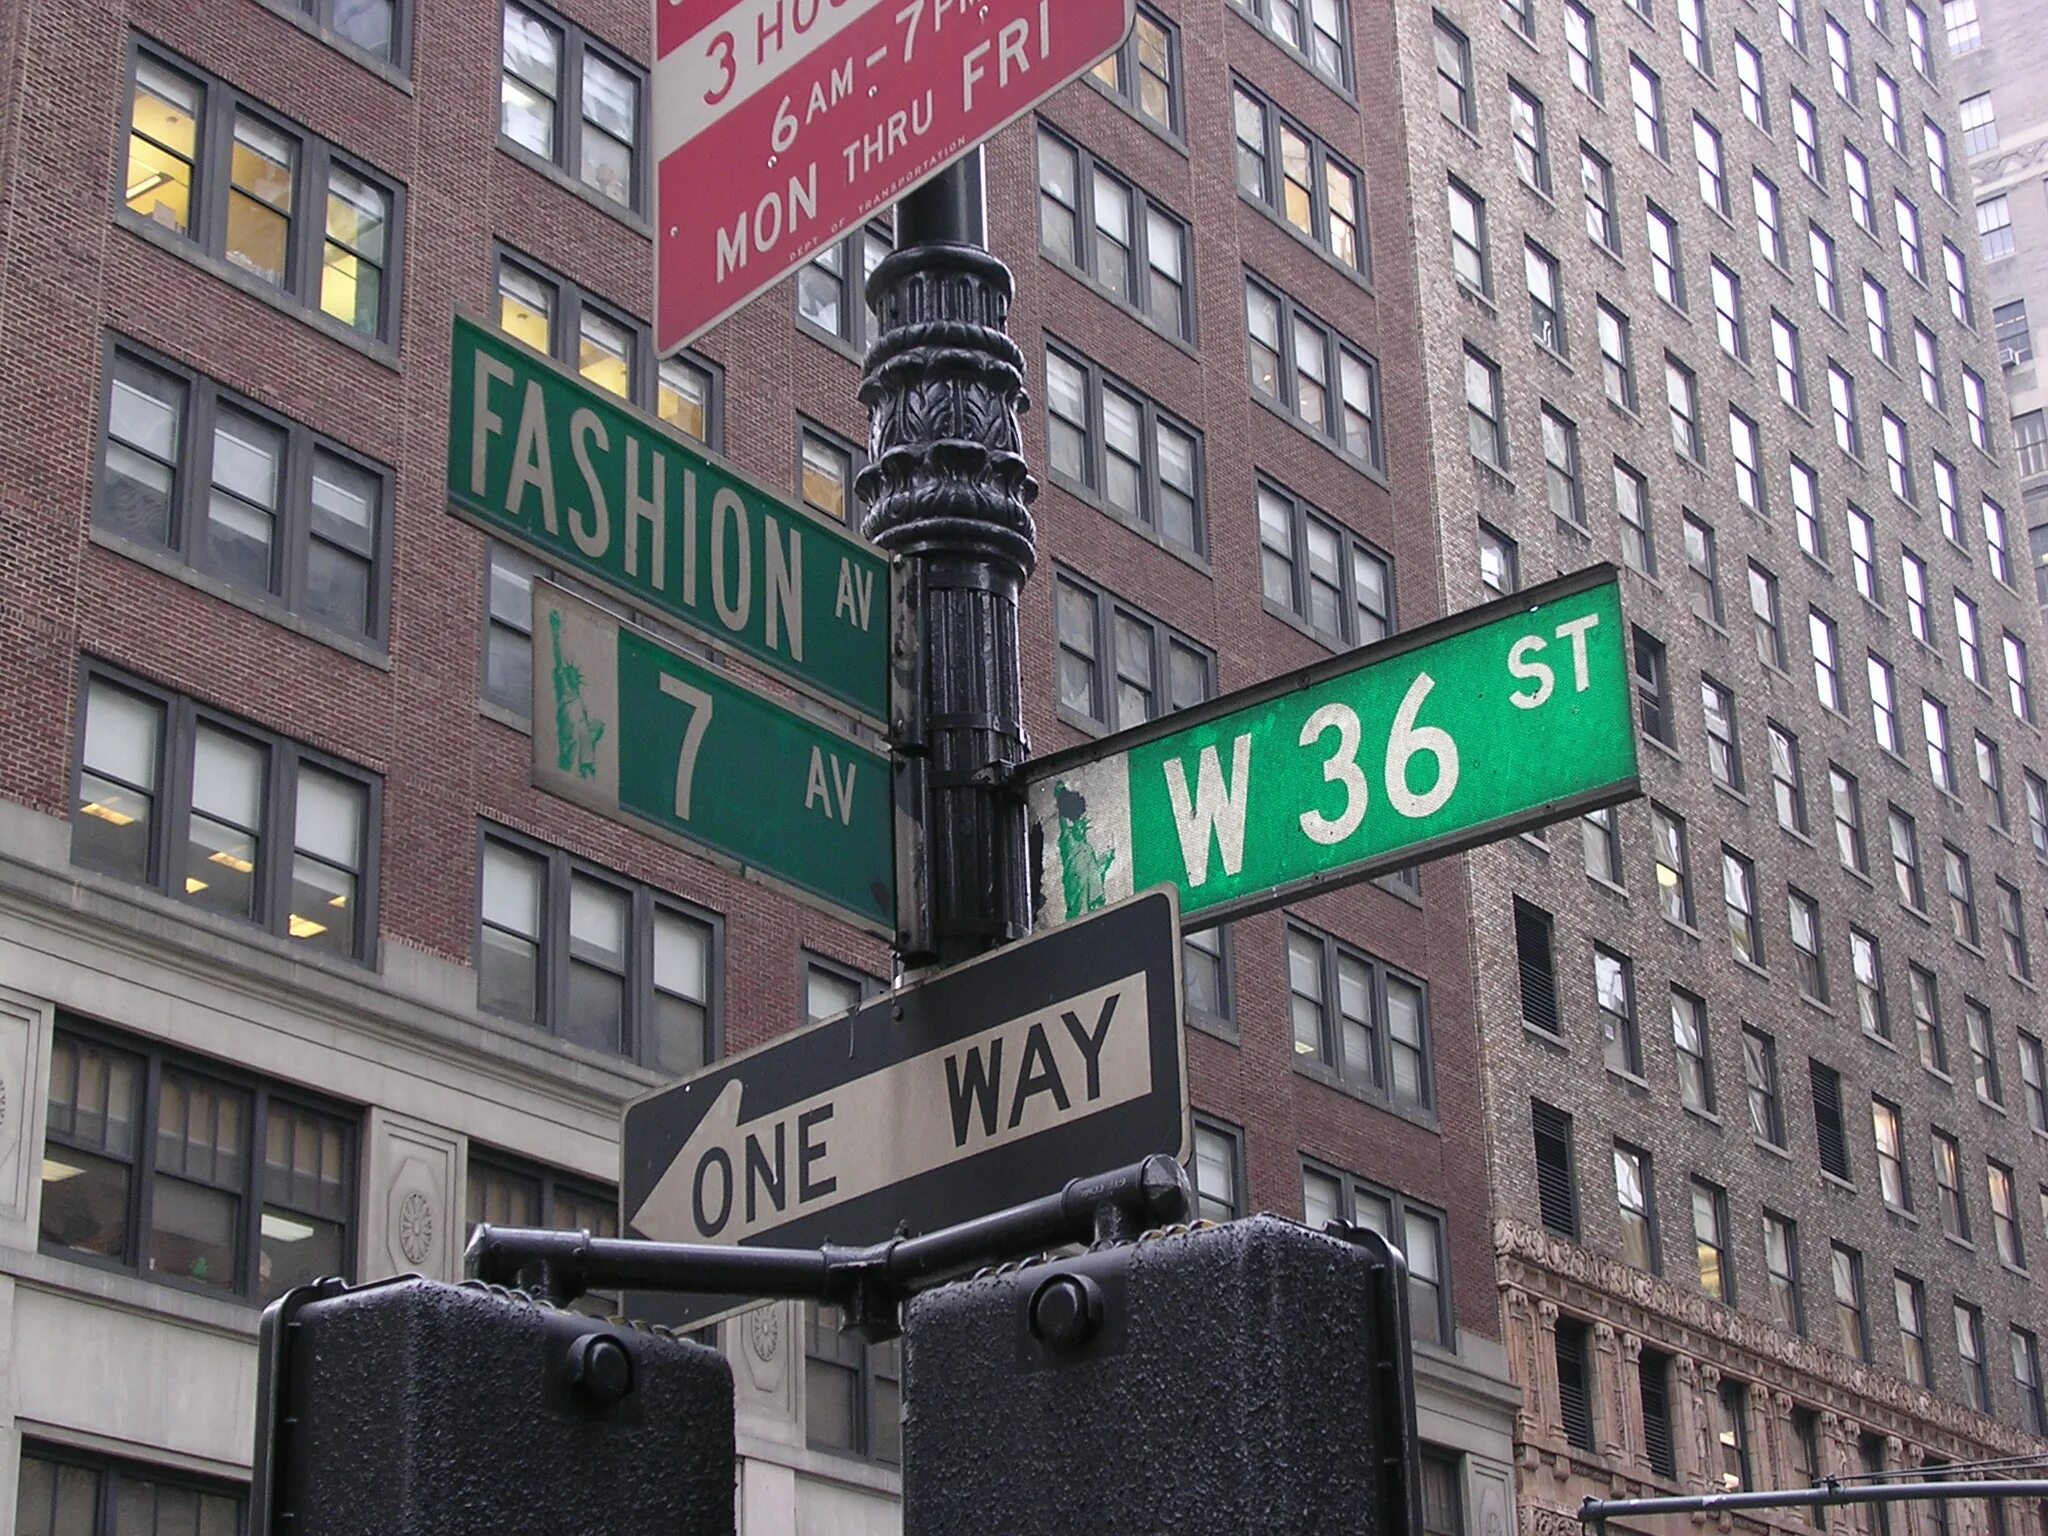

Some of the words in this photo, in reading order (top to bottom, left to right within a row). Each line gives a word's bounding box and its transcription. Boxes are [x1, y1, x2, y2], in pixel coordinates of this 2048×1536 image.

[703, 30, 737, 106] 3
[757, 0, 849, 65] HO
[716, 162, 818, 283] MON
[843, 89, 933, 184] THRU
[963, 0, 1049, 113] FRI
[789, 236, 819, 262] DEPT
[831, 217, 846, 233] OF
[858, 135, 967, 214] TRANSPORTATION
[471, 349, 804, 662] FASHION
[835, 556, 874, 632] AV
[659, 671, 714, 822] 7
[805, 745, 857, 826] AV
[1163, 733, 1251, 888] W
[1298, 671, 1460, 846] 36
[1507, 613, 1600, 709] ST
[692, 1102, 838, 1239] ONE
[944, 992, 1121, 1148] WAY
